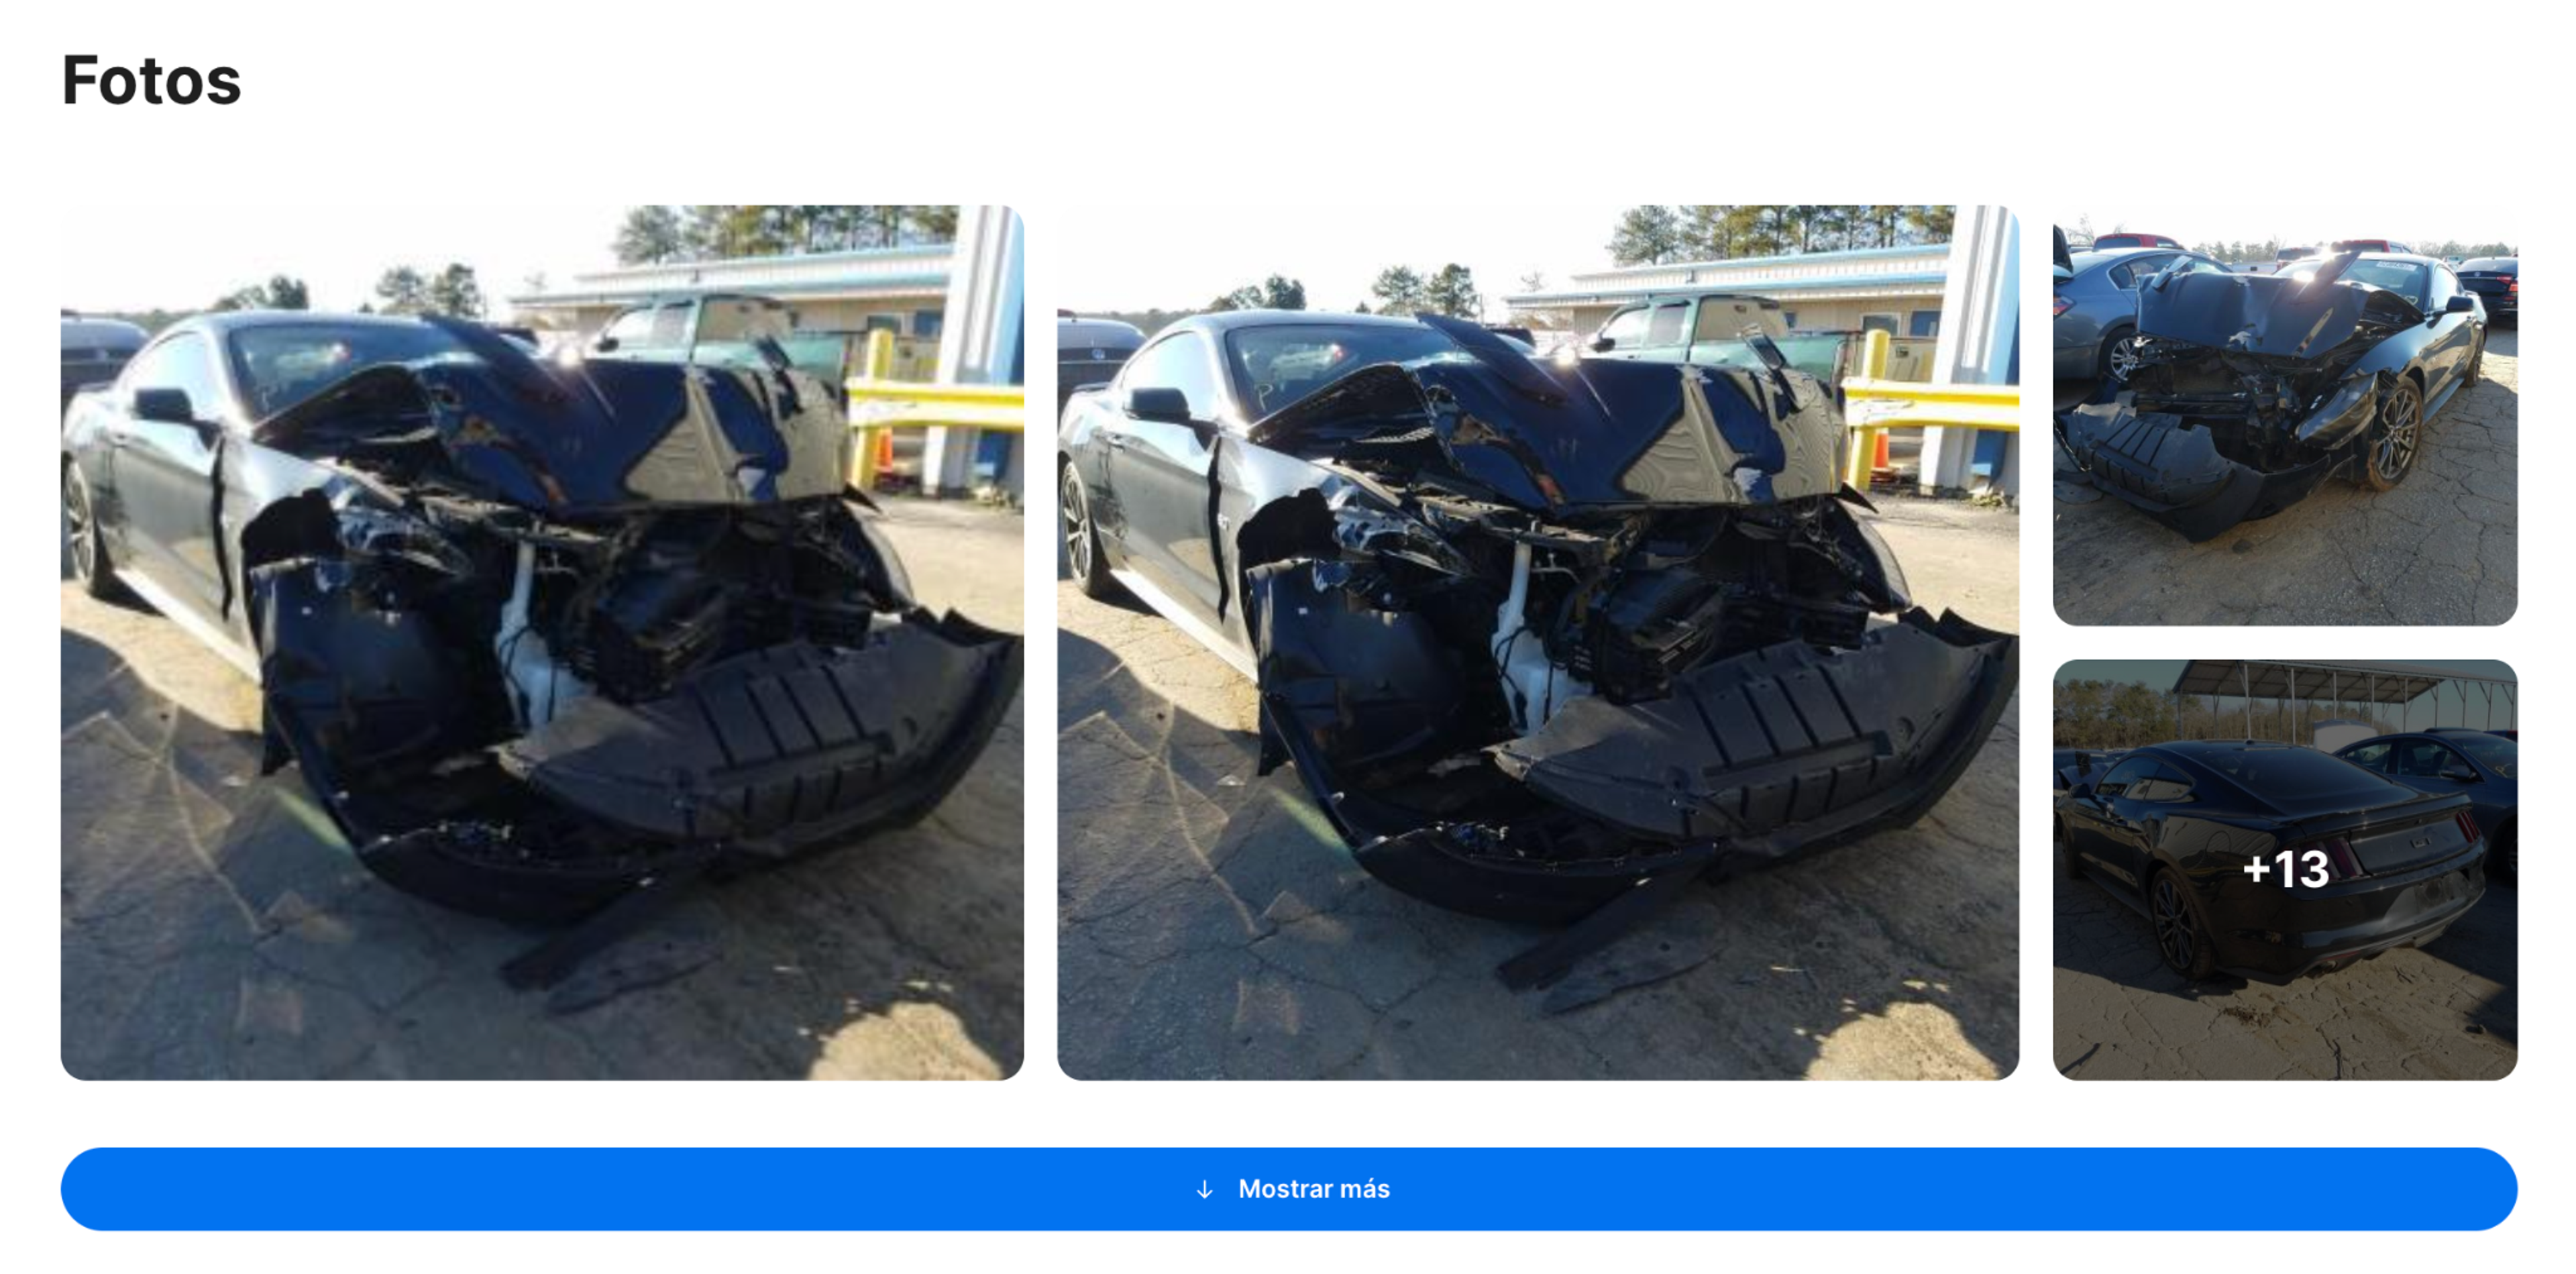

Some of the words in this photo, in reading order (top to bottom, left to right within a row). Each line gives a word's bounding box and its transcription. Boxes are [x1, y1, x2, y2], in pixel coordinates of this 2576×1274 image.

[64, 54, 241, 105] Fotos
[1240, 1179, 1334, 1199] Mostrar
[1340, 1177, 1390, 1199] más
